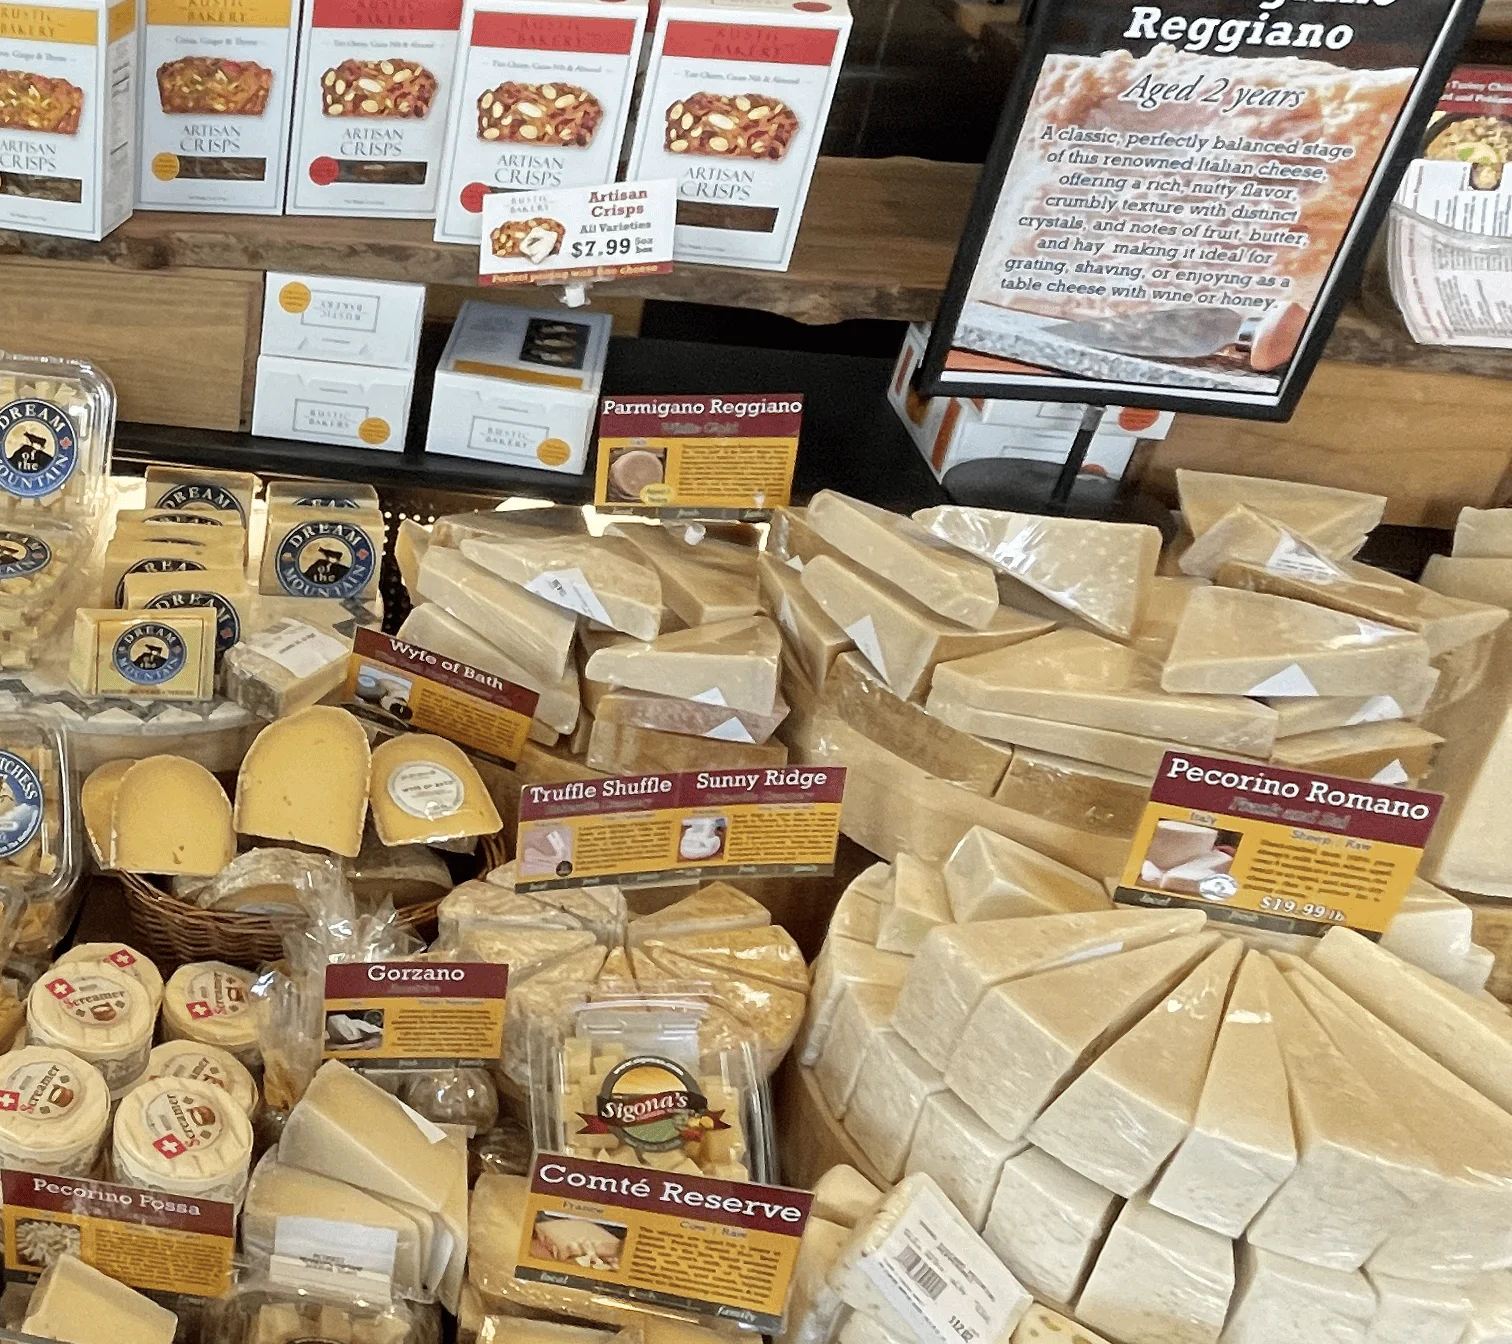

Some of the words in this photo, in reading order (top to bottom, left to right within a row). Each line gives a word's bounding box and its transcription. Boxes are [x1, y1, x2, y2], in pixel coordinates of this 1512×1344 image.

[1123, 6, 1355, 53] Reggiano
[1123, 74, 1206, 108] Aged
[1201, 78, 1230, 103] 2
[1223, 84, 1306, 113] years
[180, 138, 240, 153] CRISPS
[182, 125, 241, 138] ARTISAN
[1040, 126, 1055, 140] A
[1058, 129, 1121, 146] classic,
[1126, 133, 1209, 149] perfectly
[1213, 136, 1301, 156] balanced
[1303, 144, 1354, 159] stage
[0, 139, 57, 157] ARTISAN
[0, 156, 57, 173] CRISPS
[1047, 150, 1067, 164] of
[1069, 150, 1100, 164] this
[1103, 155, 1194, 172] renowned
[1196, 158, 1253, 174] Italian
[1257, 164, 1329, 182] cheese,
[1059, 173, 1128, 192] offering
[1131, 179, 1142, 189] a
[1147, 178, 1188, 194] rich,
[1193, 182, 1240, 199] nutty
[1242, 185, 1298, 202] flavor,
[1046, 195, 1119, 214] crumbly
[1122, 200, 1183, 216] texture
[1189, 203, 1228, 218] with
[1232, 206, 1298, 223] distinct
[1019, 216, 1088, 233] crystals,
[1093, 218, 1124, 232] and
[1129, 222, 1177, 236] notes
[1182, 223, 1202, 237] of
[1249, 229, 1310, 246] butter,
[571, 238, 632, 258] $7.99
[1037, 238, 1068, 251] and
[1073, 239, 1105, 255] hay
[1113, 243, 1178, 261] making
[1182, 247, 1197, 260] it
[1200, 248, 1244, 263] ideal
[1247, 250, 1274, 264] for
[1005, 258, 1070, 275] grating,
[1075, 262, 1146, 279] shaving,
[1152, 269, 1170, 279] or
[1176, 269, 1251, 288] enjoying
[1256, 277, 1276, 287] as
[1279, 279, 1290, 289] a
[1000, 277, 1042, 291] table
[1046, 281, 1106, 296] cheese
[1111, 286, 1146, 299] with
[1152, 289, 1193, 302] wine
[1198, 293, 1217, 303] or
[1220, 294, 1279, 312] honey.
[602, 399, 706, 417] Parmigano
[709, 399, 803, 417] Reggiano
[17, 458, 39, 472] the
[21, 449, 36, 462] of
[390, 639, 437, 666] Wyfe
[440, 657, 460, 677] of
[464, 664, 504, 693] Bath
[529, 782, 597, 805] Truffle
[602, 776, 673, 798] Shuffle
[696, 770, 761, 791] Sunny
[764, 769, 828, 789] Ridge
[1167, 758, 1300, 801] Pecorino
[1305, 780, 1431, 822] Romano
[1259, 895, 1327, 919] $19.99
[1327, 908, 1346, 922] lb
[366, 962, 466, 992] Gorzano
[62, 988, 126, 1011] Screamer
[538, 1162, 653, 1198] Comté
[658, 1181, 803, 1223] Reserve
